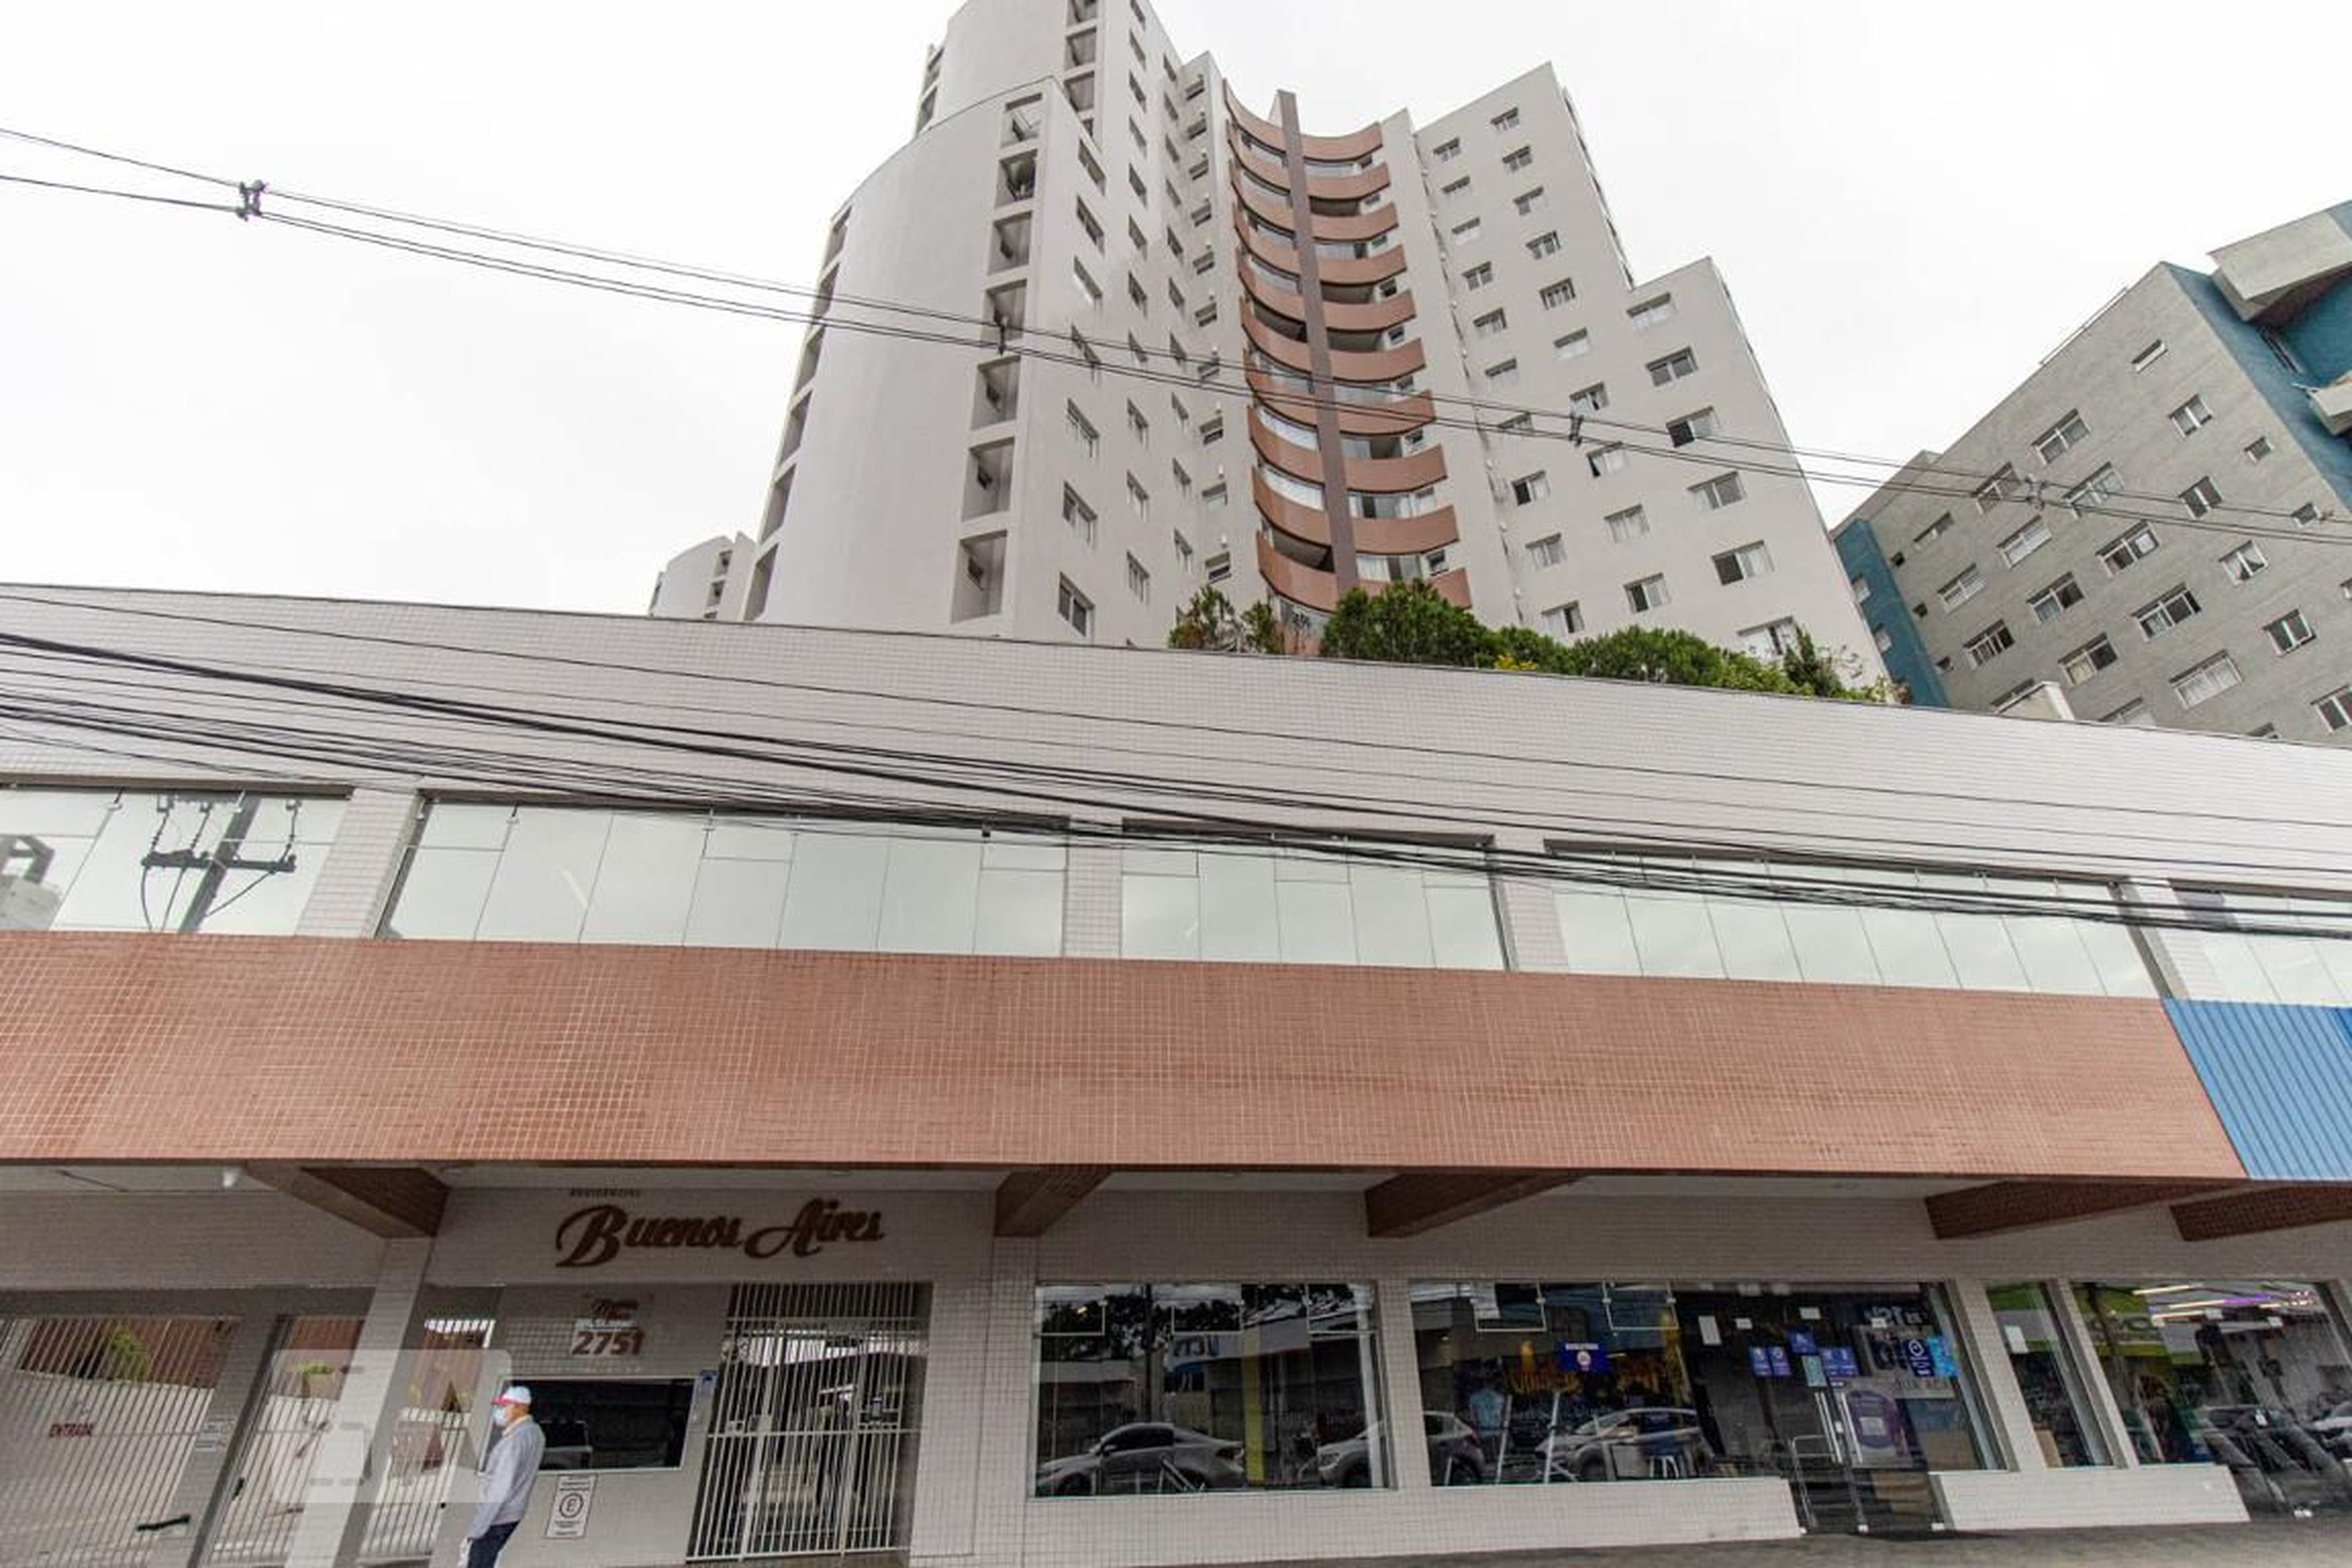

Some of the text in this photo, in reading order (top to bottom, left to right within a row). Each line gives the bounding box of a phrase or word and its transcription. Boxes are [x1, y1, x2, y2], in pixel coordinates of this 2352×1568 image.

[555, 1198, 886, 1267] Buenos Aires
[572, 1330, 644, 1355] 2751
